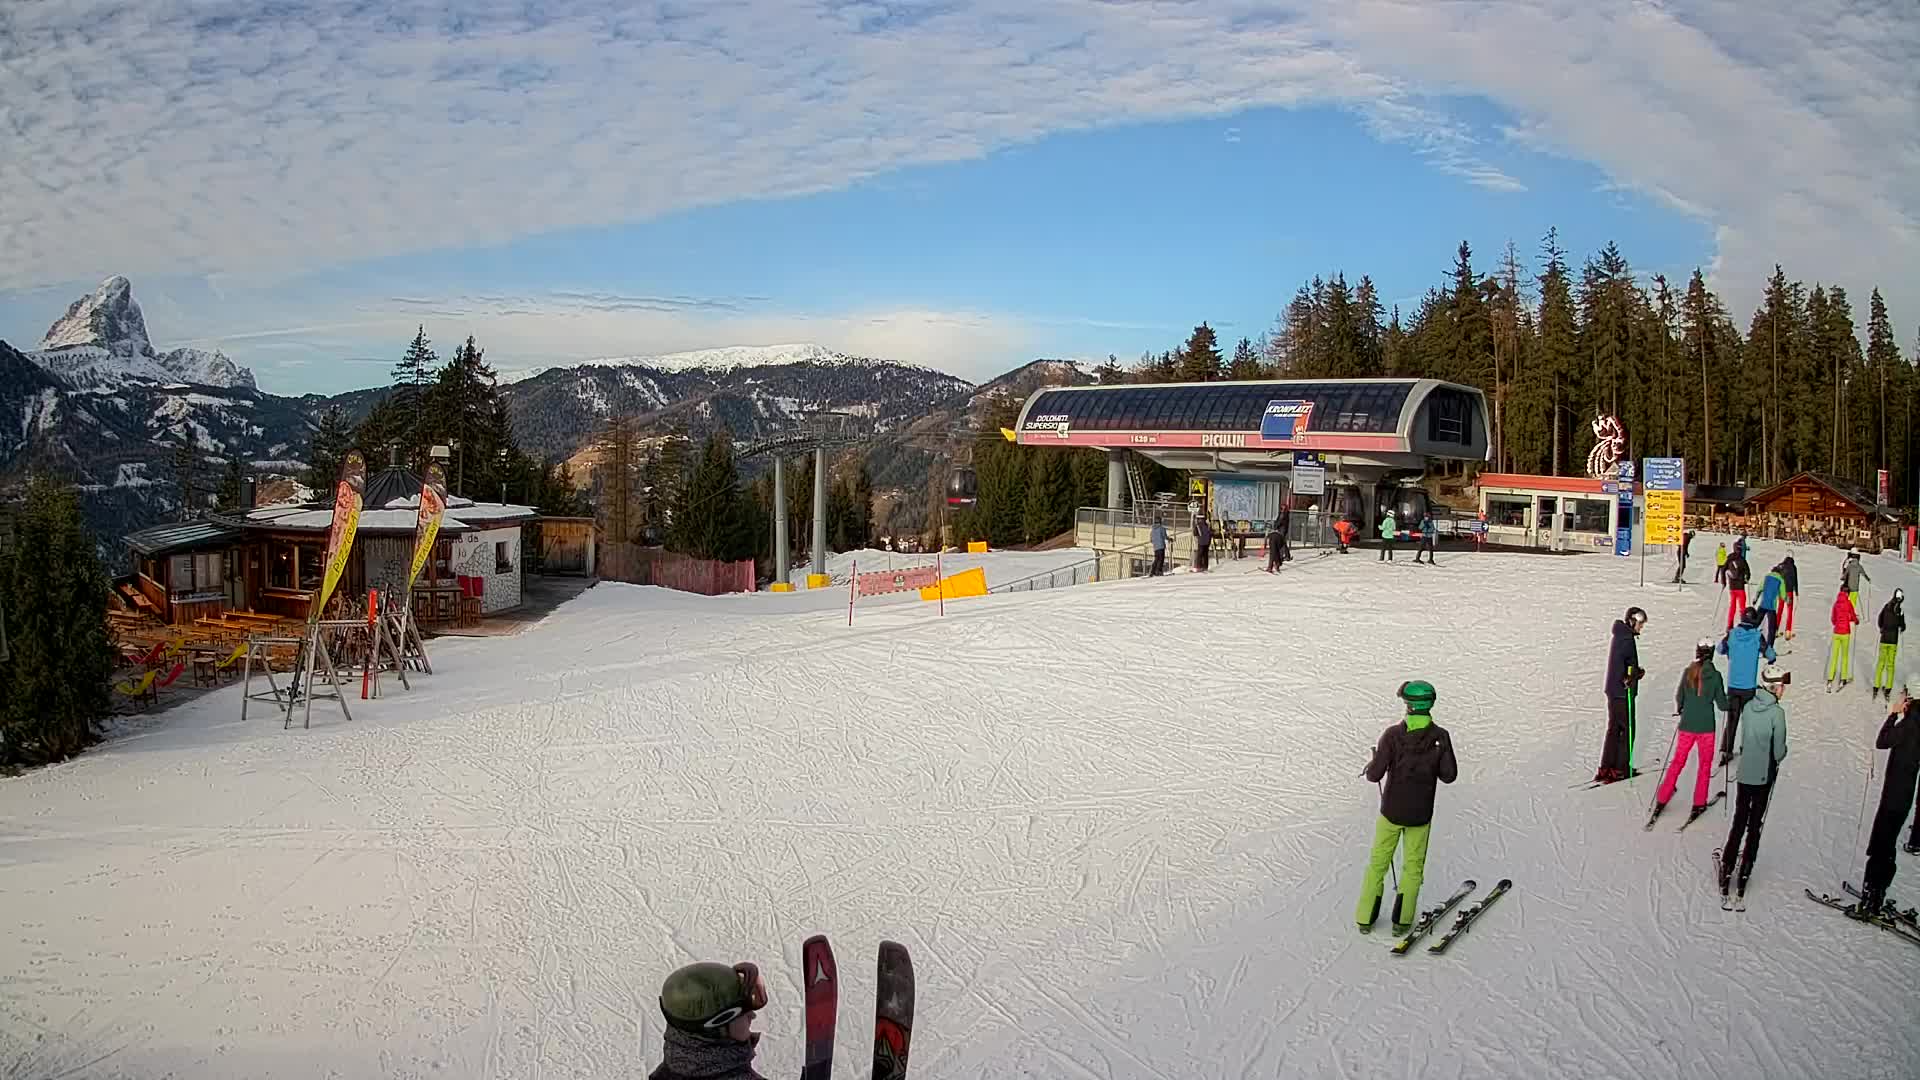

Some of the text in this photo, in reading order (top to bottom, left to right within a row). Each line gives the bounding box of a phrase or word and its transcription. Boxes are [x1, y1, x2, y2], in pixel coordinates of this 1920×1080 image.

[1036, 414, 1069, 422] DOLOMITI
[1201, 433, 1246, 447] PICULIN
[332, 513, 358, 574] PIZZERIA
